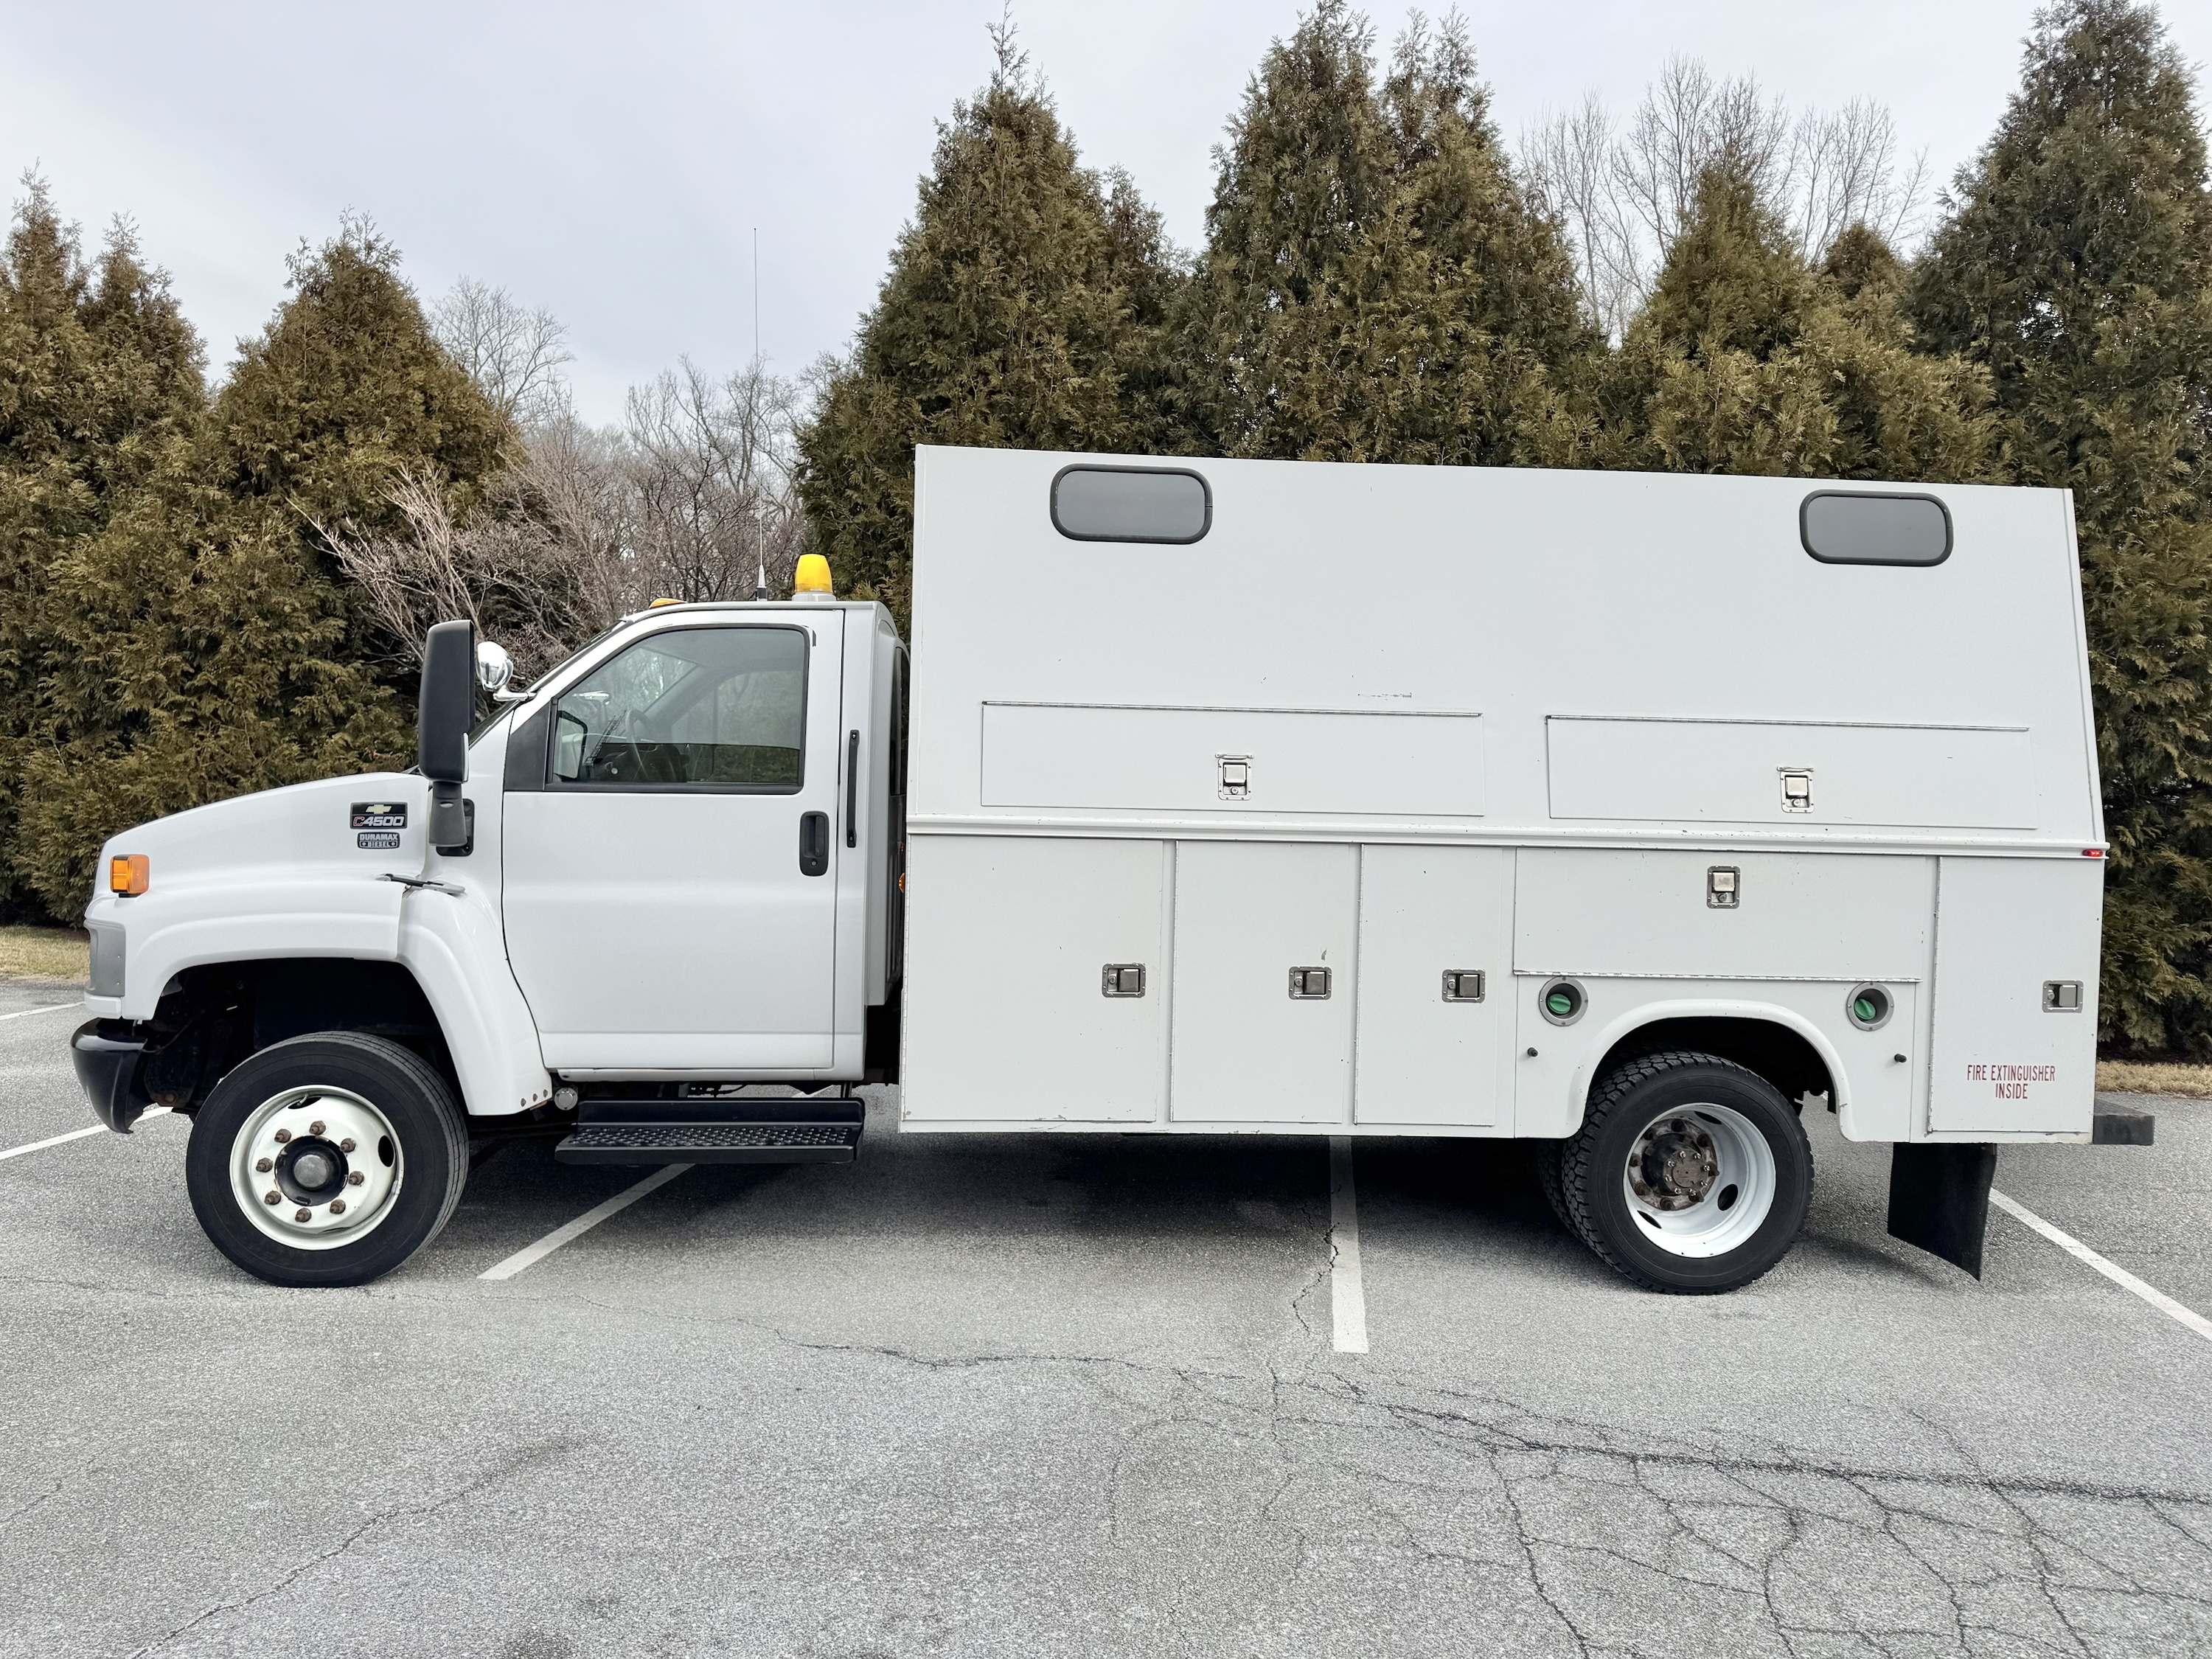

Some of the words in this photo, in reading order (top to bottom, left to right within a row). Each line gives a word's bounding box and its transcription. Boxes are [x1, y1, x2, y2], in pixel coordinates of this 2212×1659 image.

[352, 815, 405, 827] C4500
[1967, 1065, 1987, 1081] FIRE
[1991, 1065, 2056, 1082] EXTINGUISHER
[1995, 1083, 2028, 1099] INSIDE
